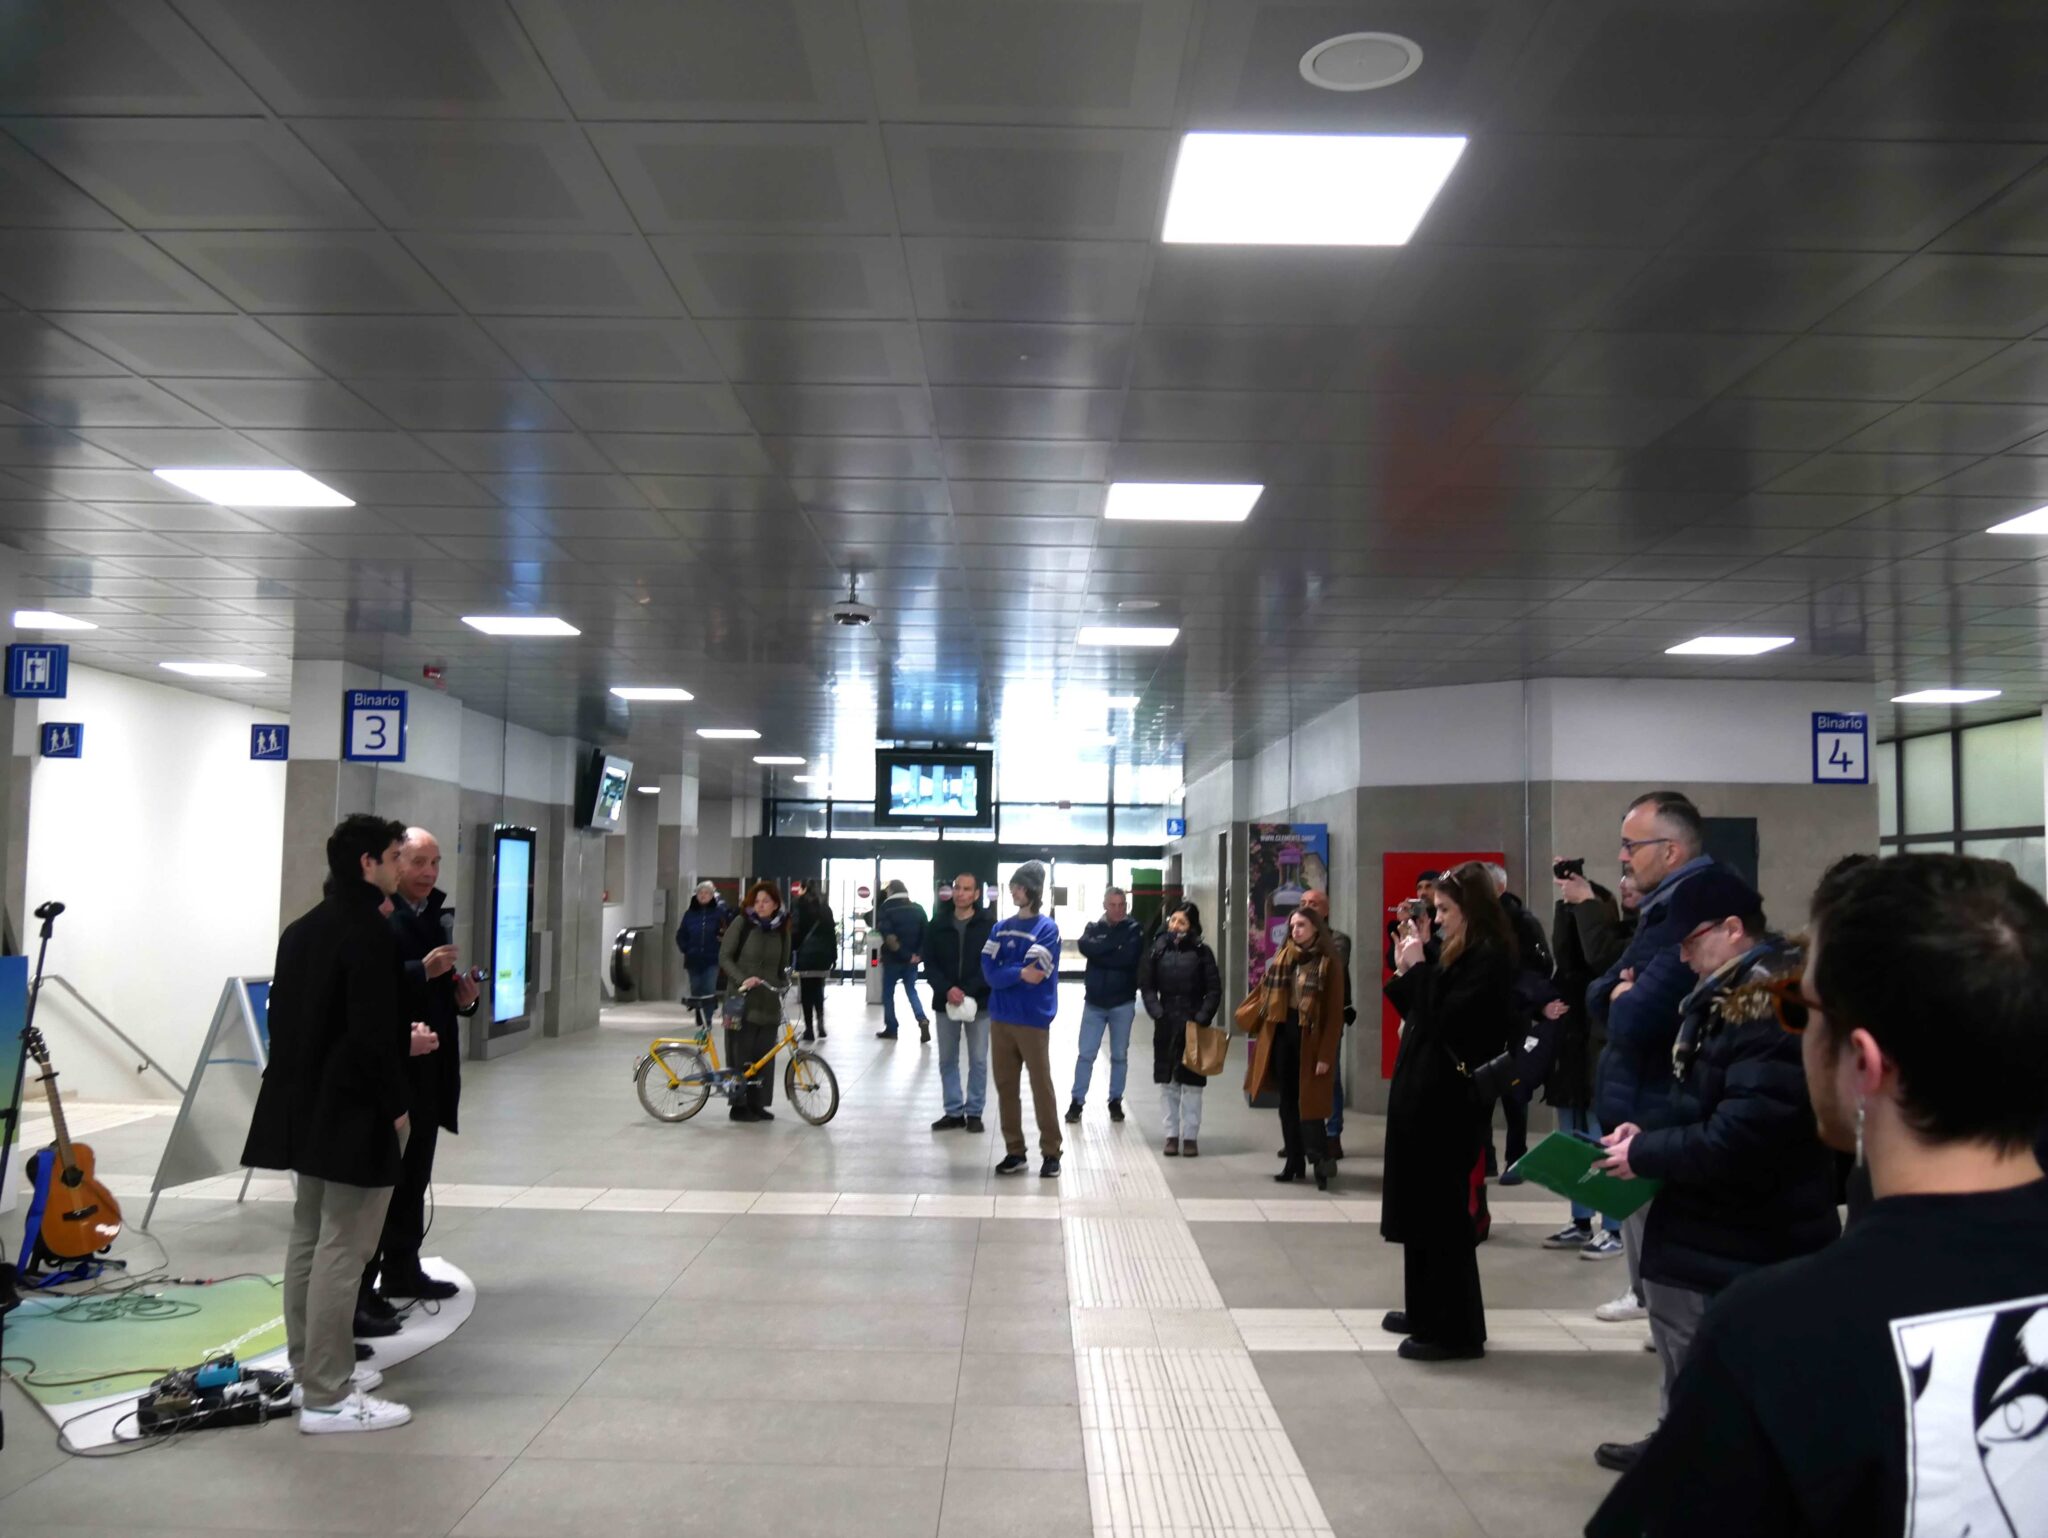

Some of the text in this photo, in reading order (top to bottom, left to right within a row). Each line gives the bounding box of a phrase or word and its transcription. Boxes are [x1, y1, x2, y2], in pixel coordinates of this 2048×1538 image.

[354, 692, 400, 706] Binario
[365, 715, 386, 750] 3
[1817, 716, 1863, 729] Binario
[1828, 738, 1853, 773] 4
